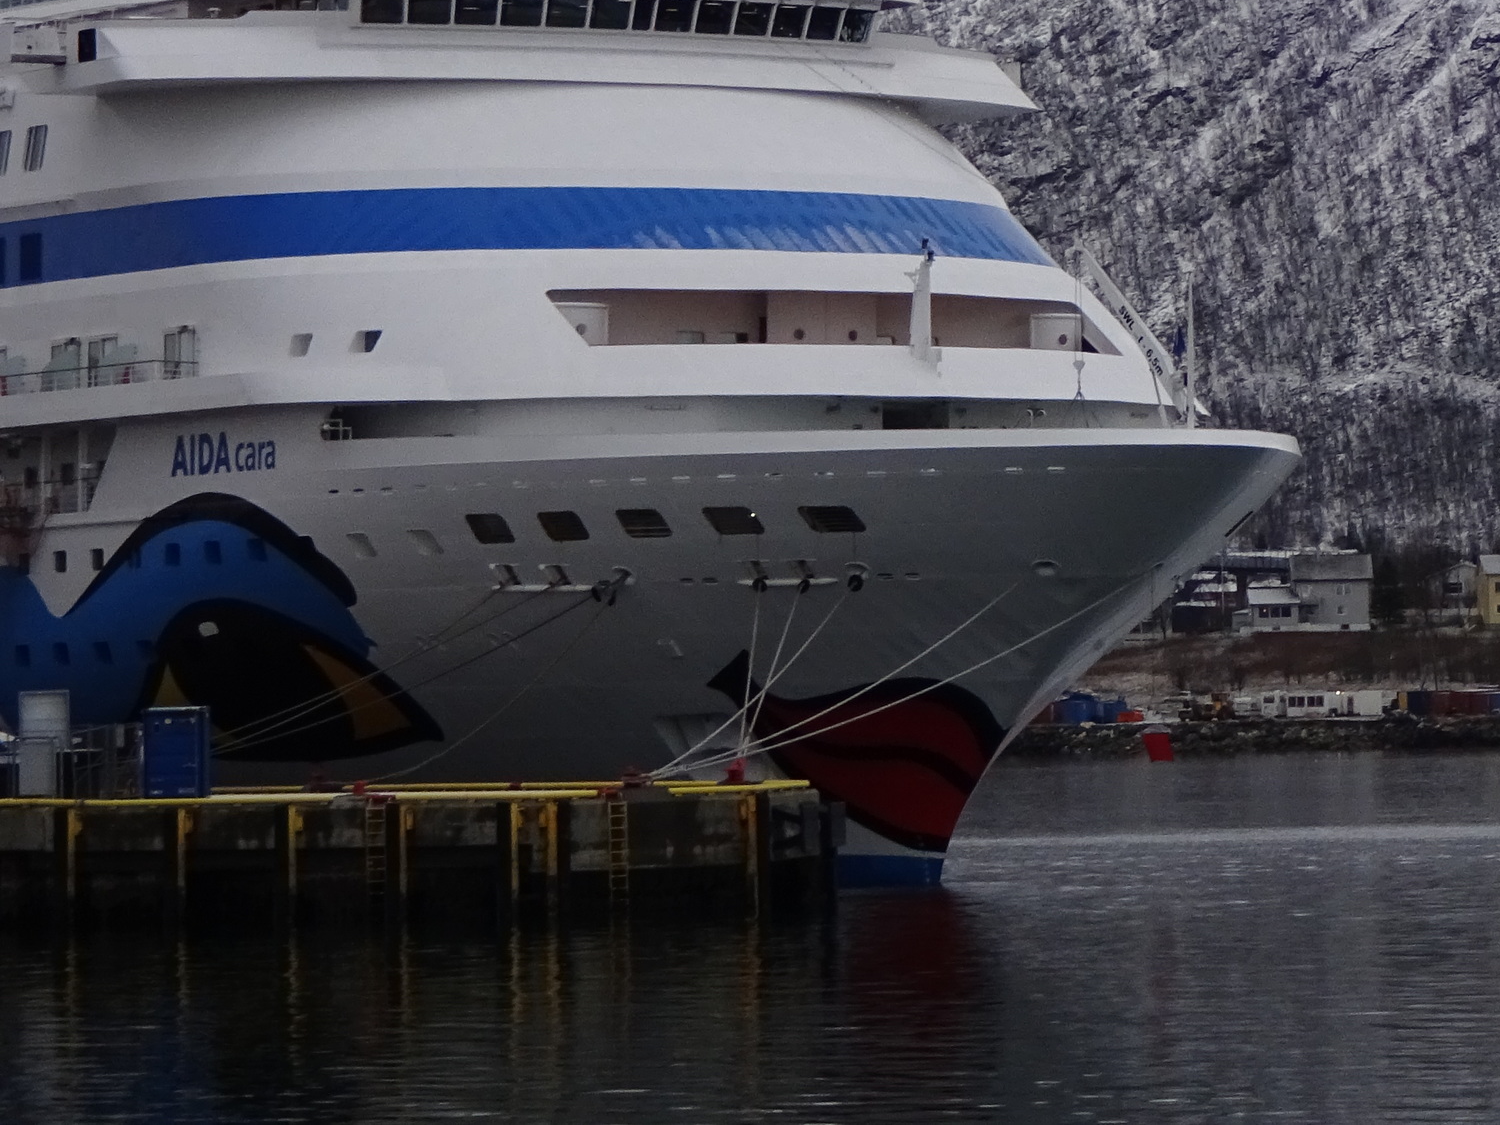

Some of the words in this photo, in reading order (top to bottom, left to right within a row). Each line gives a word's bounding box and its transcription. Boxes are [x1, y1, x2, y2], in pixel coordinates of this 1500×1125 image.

[1118, 305, 1135, 331] SWL
[171, 431, 231, 477] AIDA
[235, 440, 276, 472] cara
